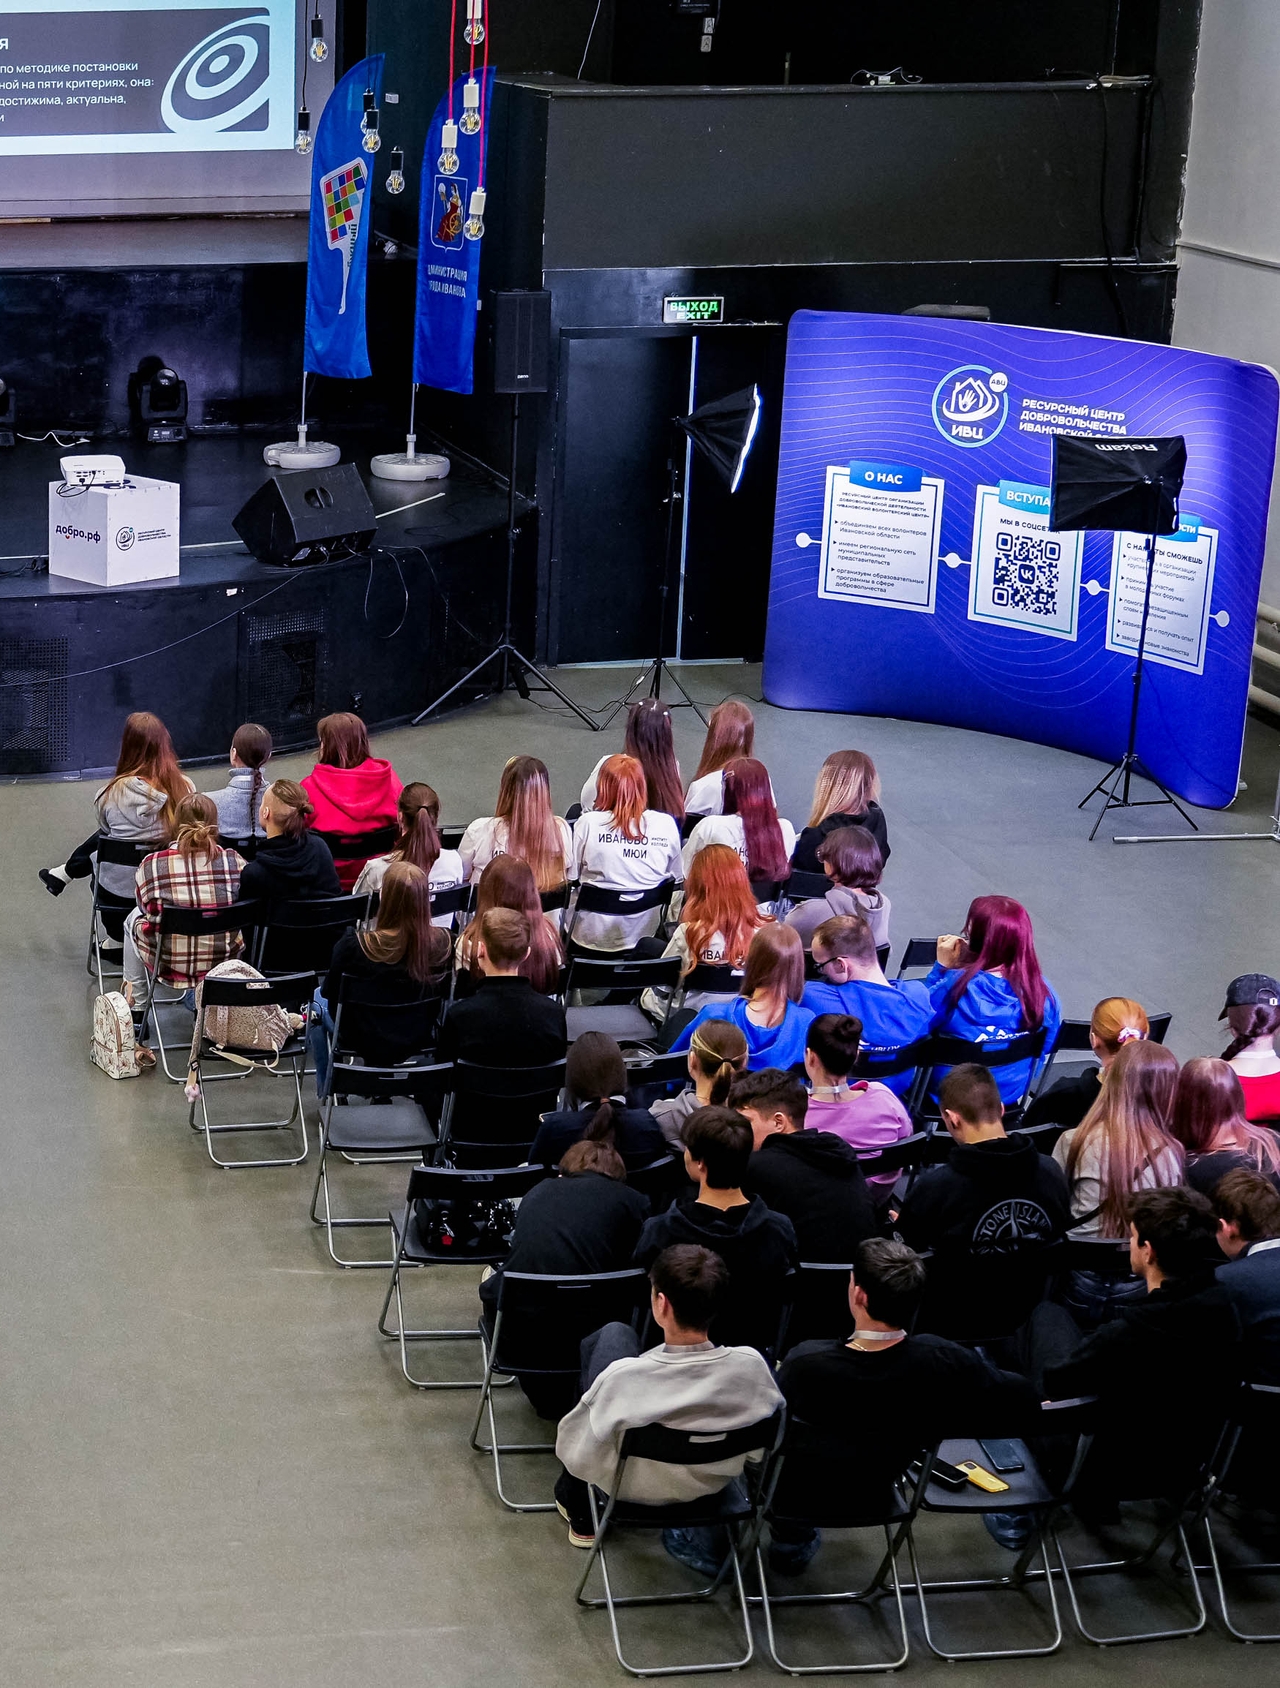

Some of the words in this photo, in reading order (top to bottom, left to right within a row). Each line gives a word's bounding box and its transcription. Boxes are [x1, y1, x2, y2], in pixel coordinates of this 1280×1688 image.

[0, 65, 14, 74] по
[16, 63, 71, 75] методике
[72, 62, 139, 73] постановки
[21, 80, 35, 90] на
[37, 80, 63, 90] пяти
[65, 79, 128, 90] критериях,
[130, 78, 155, 88] она:
[66, 94, 127, 107] актуальна,
[670, 301, 718, 312] ВЫХОД
[676, 312, 711, 320] EXIT
[1022, 398, 1089, 417] РЕСУРСНЫЙ
[1090, 408, 1125, 422] ЦЕНТР
[1020, 410, 1127, 435] ДОБРОВОЛЬЧЕСТВА
[951, 425, 984, 440] ИВЦ
[864, 471, 875, 481] О
[877, 473, 903, 484] НАС
[1006, 490, 1051, 508] ВСТУПА
[1000, 518, 1013, 526] МЫ
[1022, 522, 1060, 534] СОЦСЕТ
[55, 525, 101, 544] добро.рф
[1166, 551, 1203, 565] СМОЖЕШЬ
[622, 848, 647, 859] МЮИ
